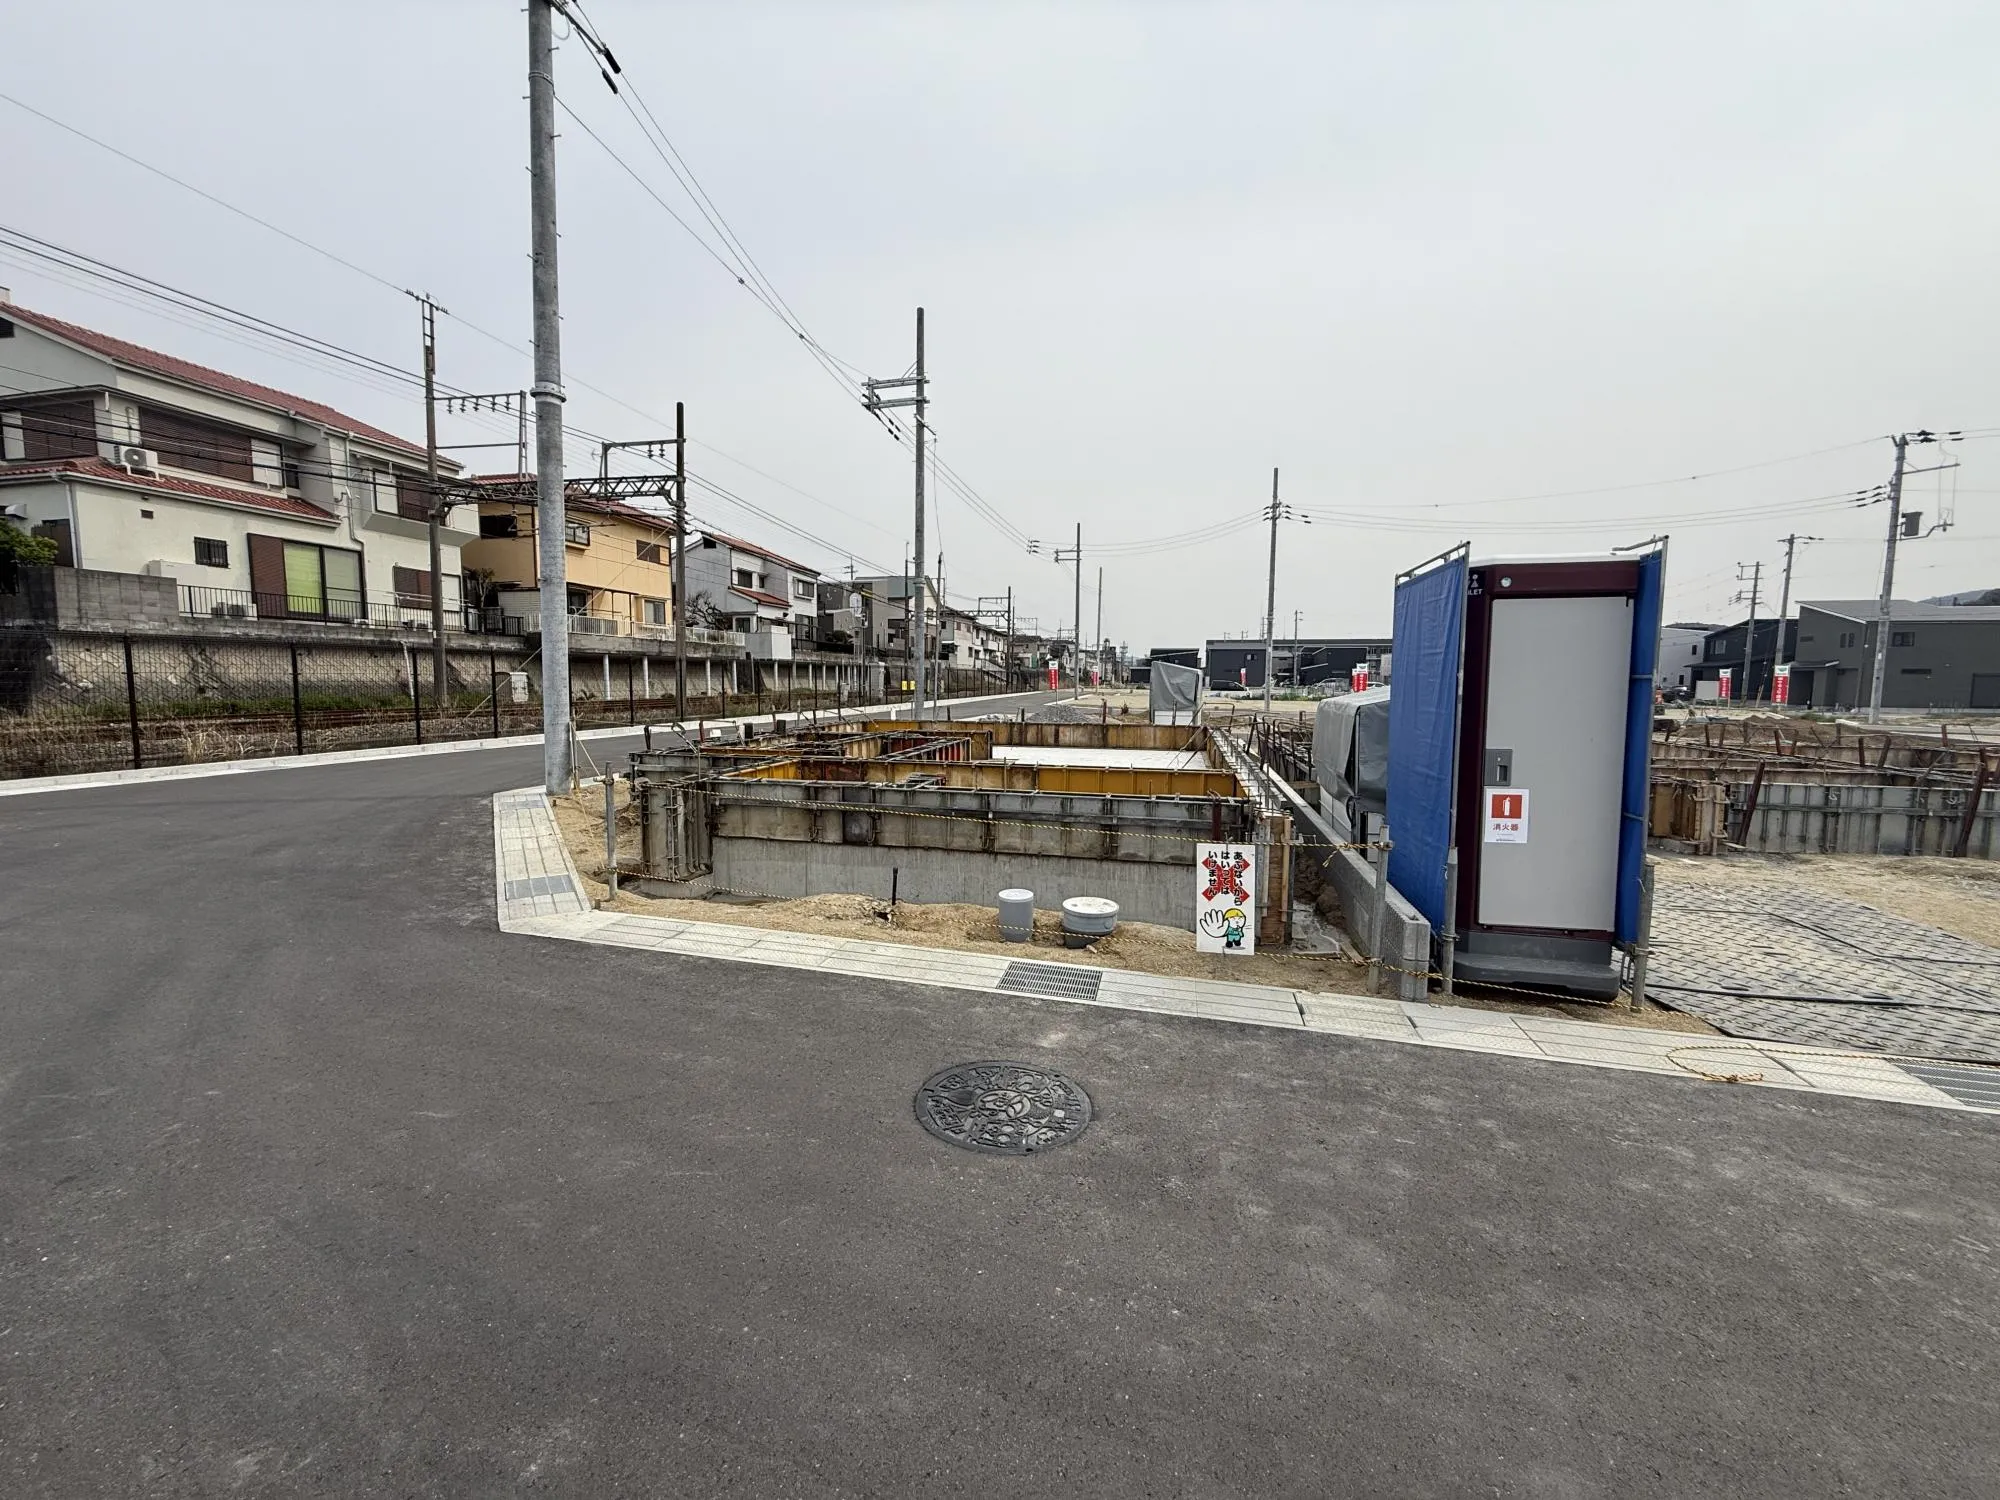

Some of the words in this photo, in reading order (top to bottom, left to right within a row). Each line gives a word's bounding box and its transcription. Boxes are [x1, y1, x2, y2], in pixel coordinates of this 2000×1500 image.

[1492, 823, 1519, 831] 消火器
[1208, 850, 1218, 897] いけません
[1220, 850, 1230, 895] はいっては
[1233, 851, 1243, 906] あぶないから
